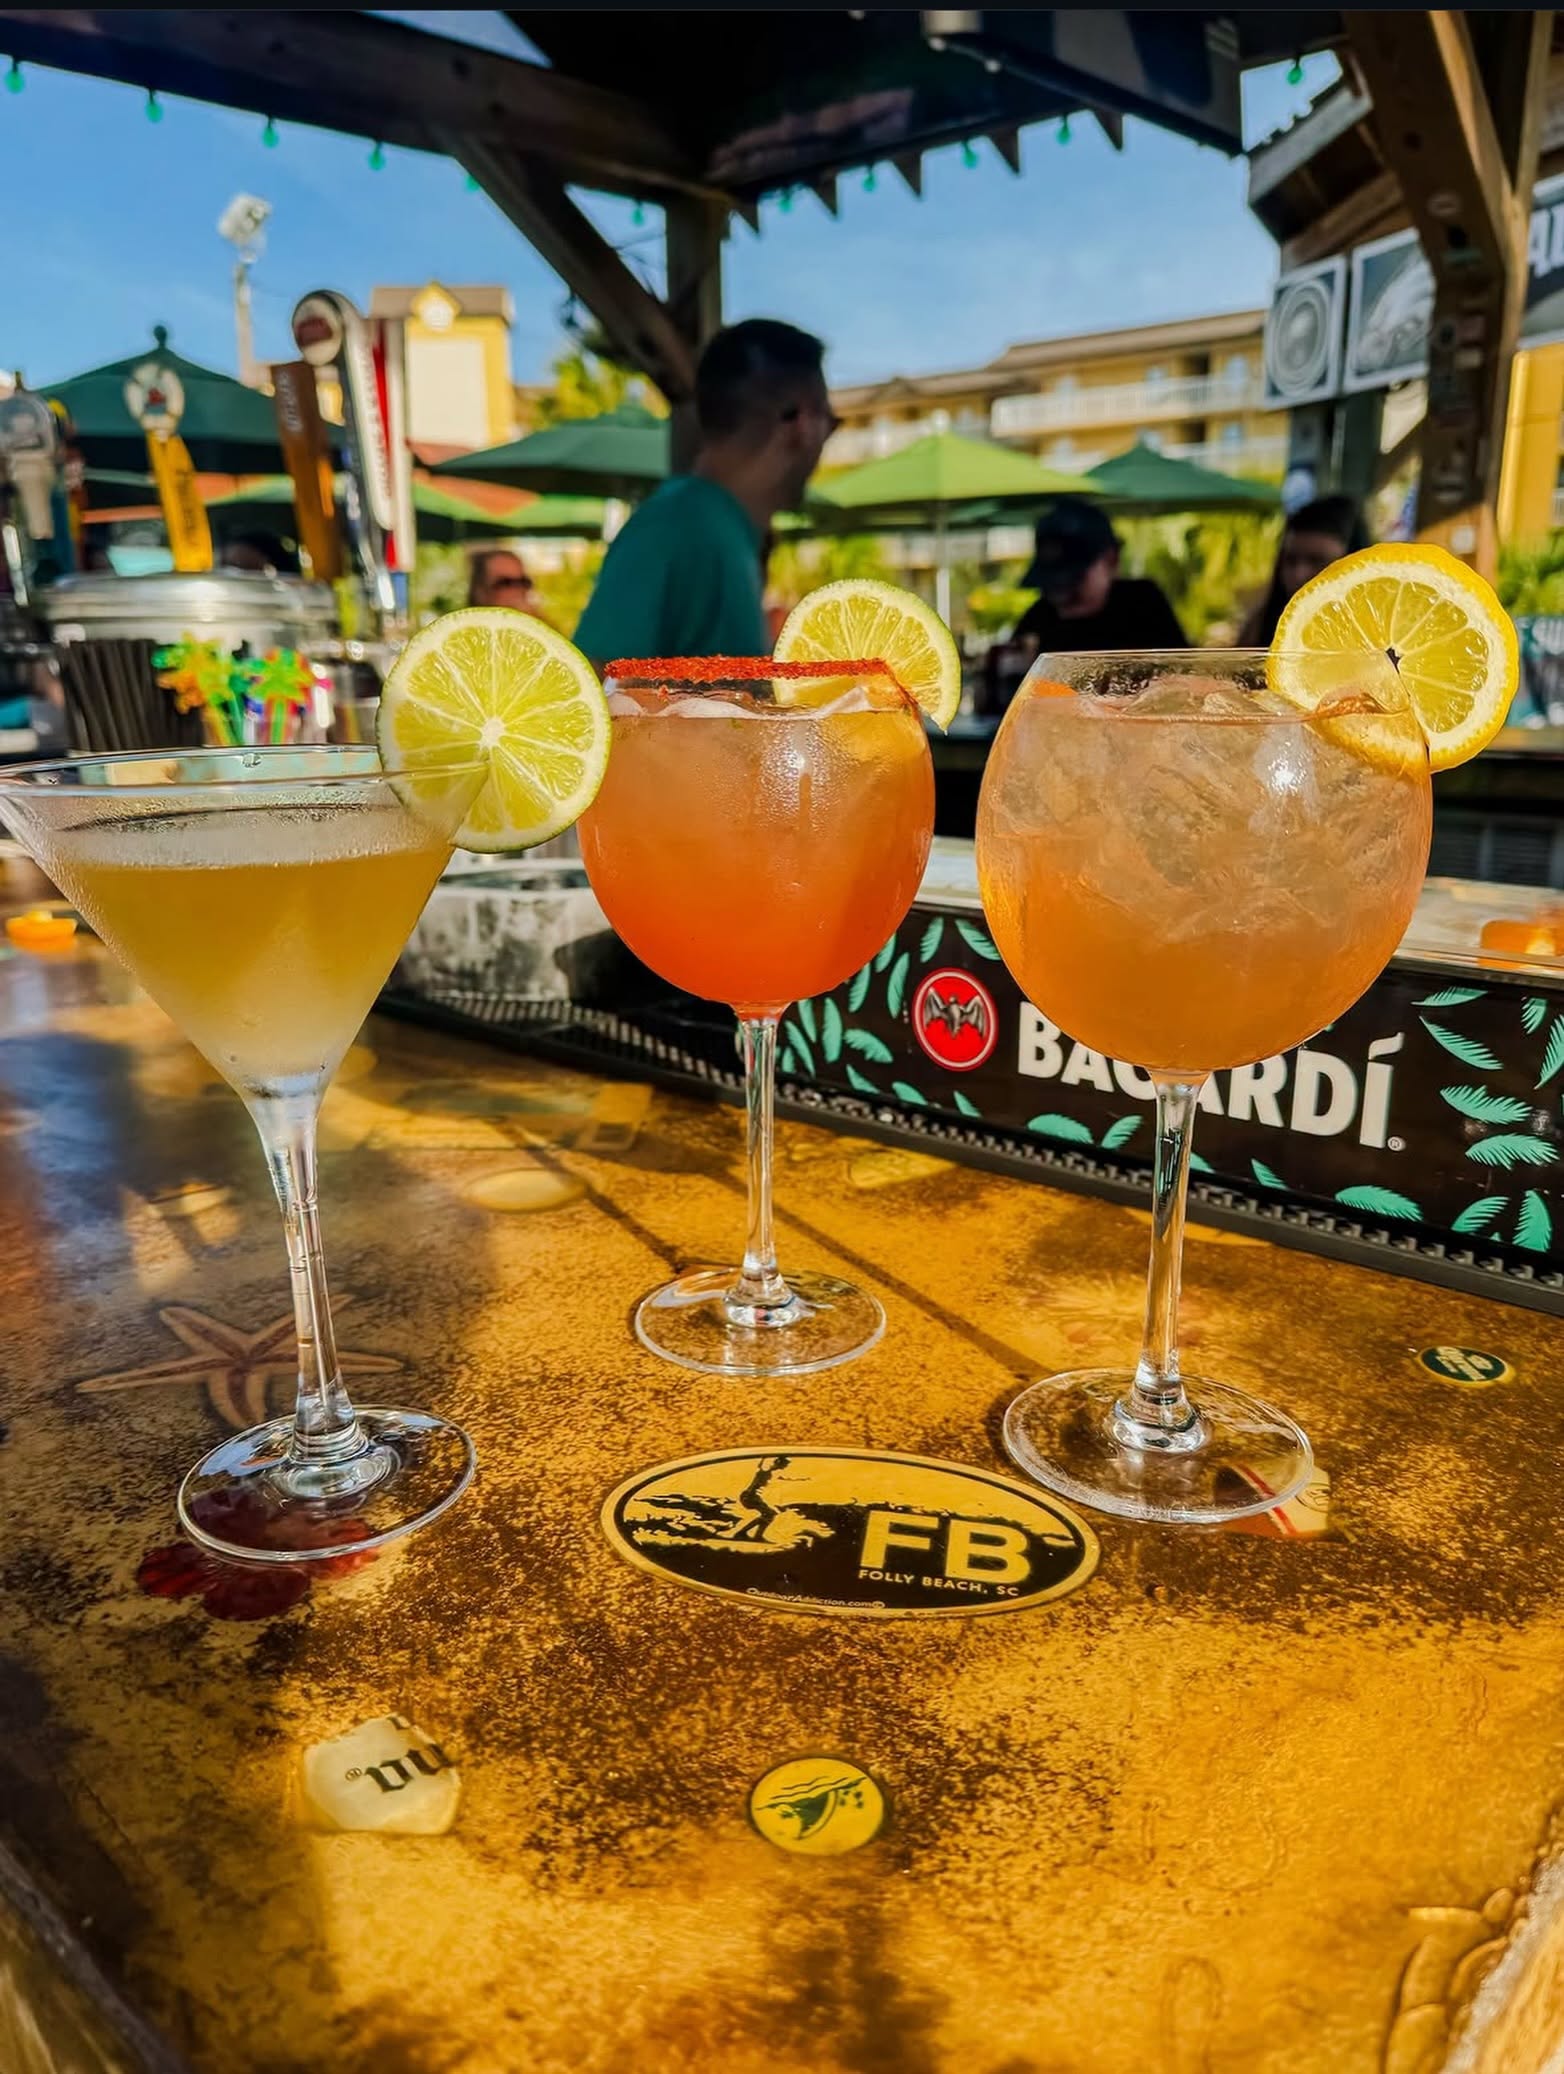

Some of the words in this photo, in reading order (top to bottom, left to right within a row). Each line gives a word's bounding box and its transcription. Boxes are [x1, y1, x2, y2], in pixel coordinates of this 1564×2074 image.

[860, 1510, 1031, 1584] FB
[858, 1569, 915, 1585] FOLLY
[996, 1585, 1020, 1597] SC
